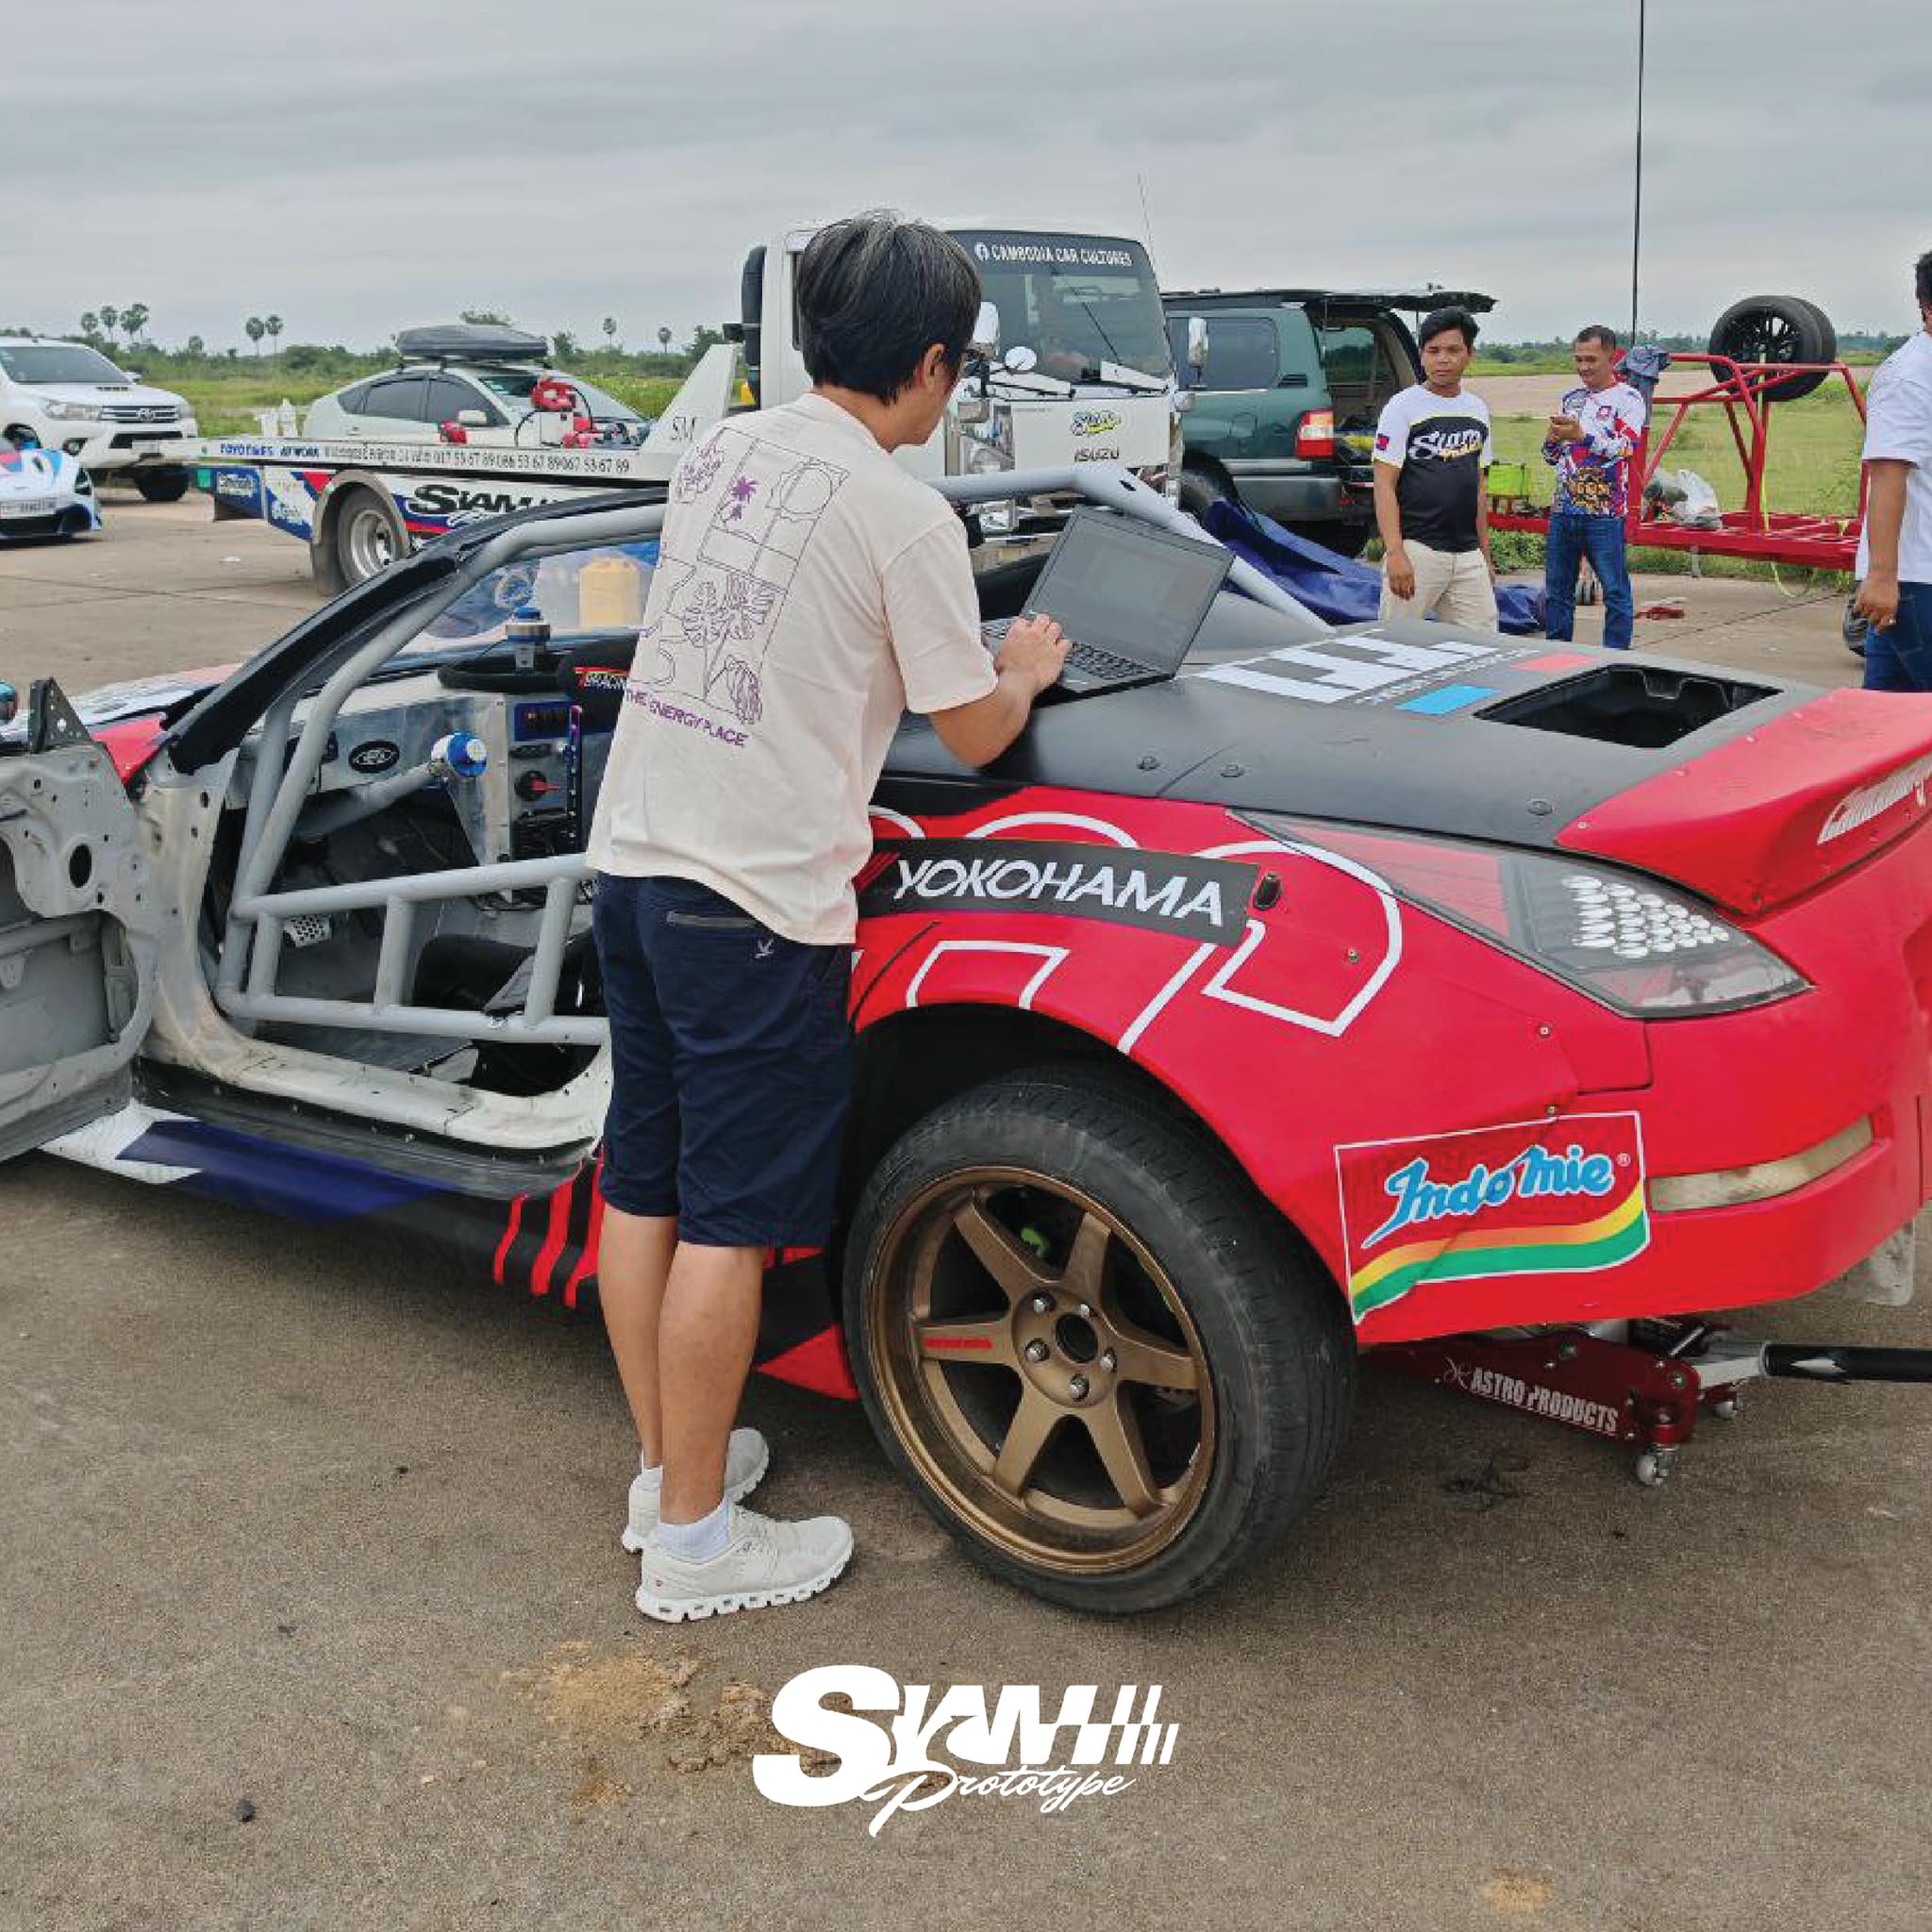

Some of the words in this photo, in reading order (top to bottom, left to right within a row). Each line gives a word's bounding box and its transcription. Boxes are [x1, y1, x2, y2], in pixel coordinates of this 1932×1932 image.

[991, 243, 1054, 262] CAMBODIA
[1056, 247, 1079, 264] CAR
[1074, 447, 1120, 462] ISUZU
[893, 858, 1224, 928] YOKOHAMA
[1470, 1367, 1526, 1404] ASTRO
[1526, 1384, 1619, 1434] PRODUCTS
